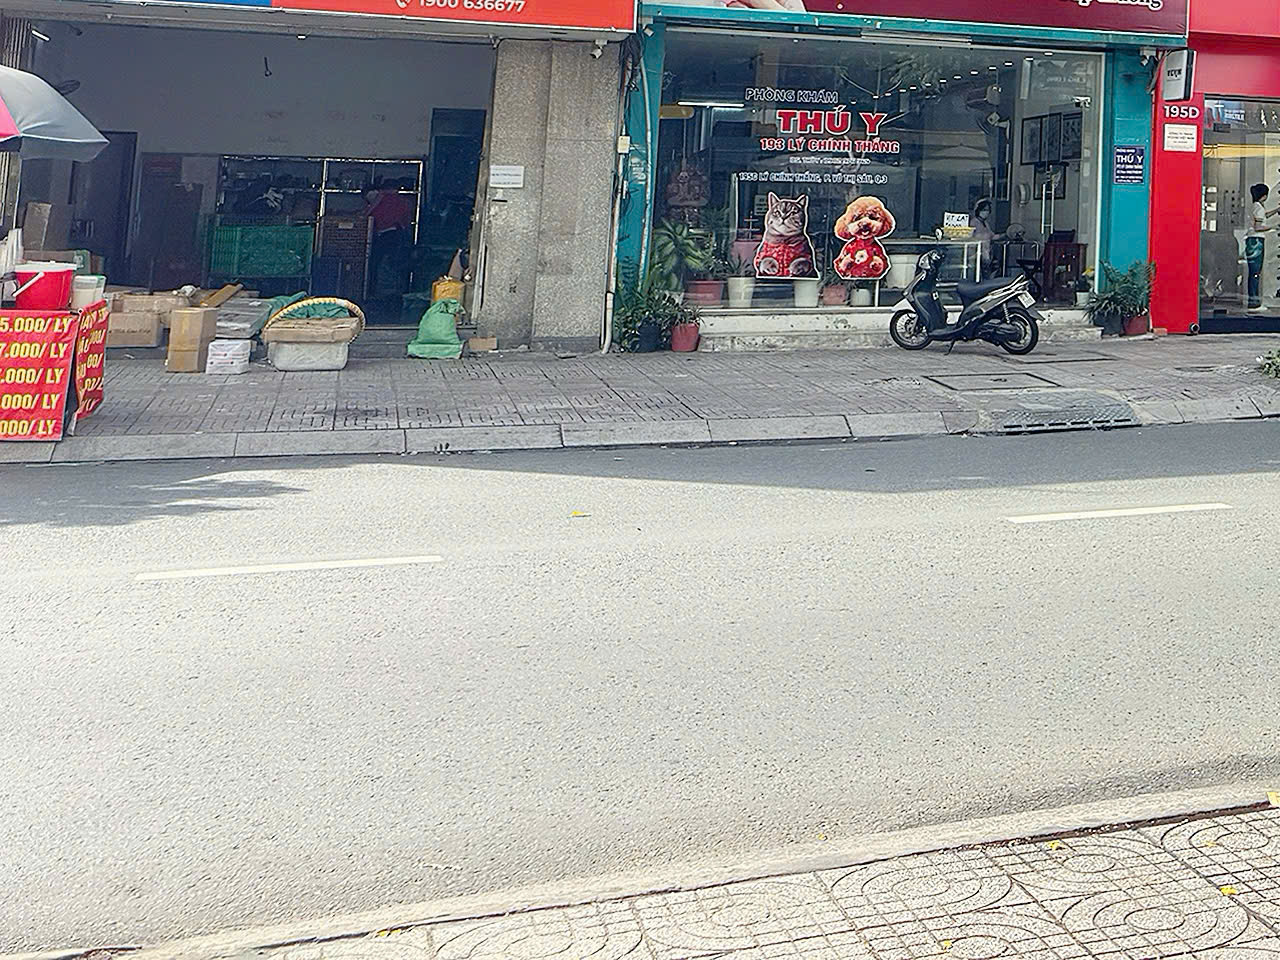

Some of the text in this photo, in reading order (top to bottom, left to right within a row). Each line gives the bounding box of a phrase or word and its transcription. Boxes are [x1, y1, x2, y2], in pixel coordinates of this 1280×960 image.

[745, 87, 839, 104] PHÒNG KHÁM
[777, 105, 887, 135] THÚ Y
[1164, 105, 1200, 119] 195D
[760, 138, 785, 151] 193
[788, 137, 806, 151] LÝ
[808, 137, 852, 152] CHÍNH
[1116, 153, 1143, 163] THÚ Y
[53, 317, 73, 333] LY
[50, 342, 69, 359] LY
[45, 368, 64, 384] LY
[42, 393, 60, 410] LY
[38, 419, 57, 436] LY
